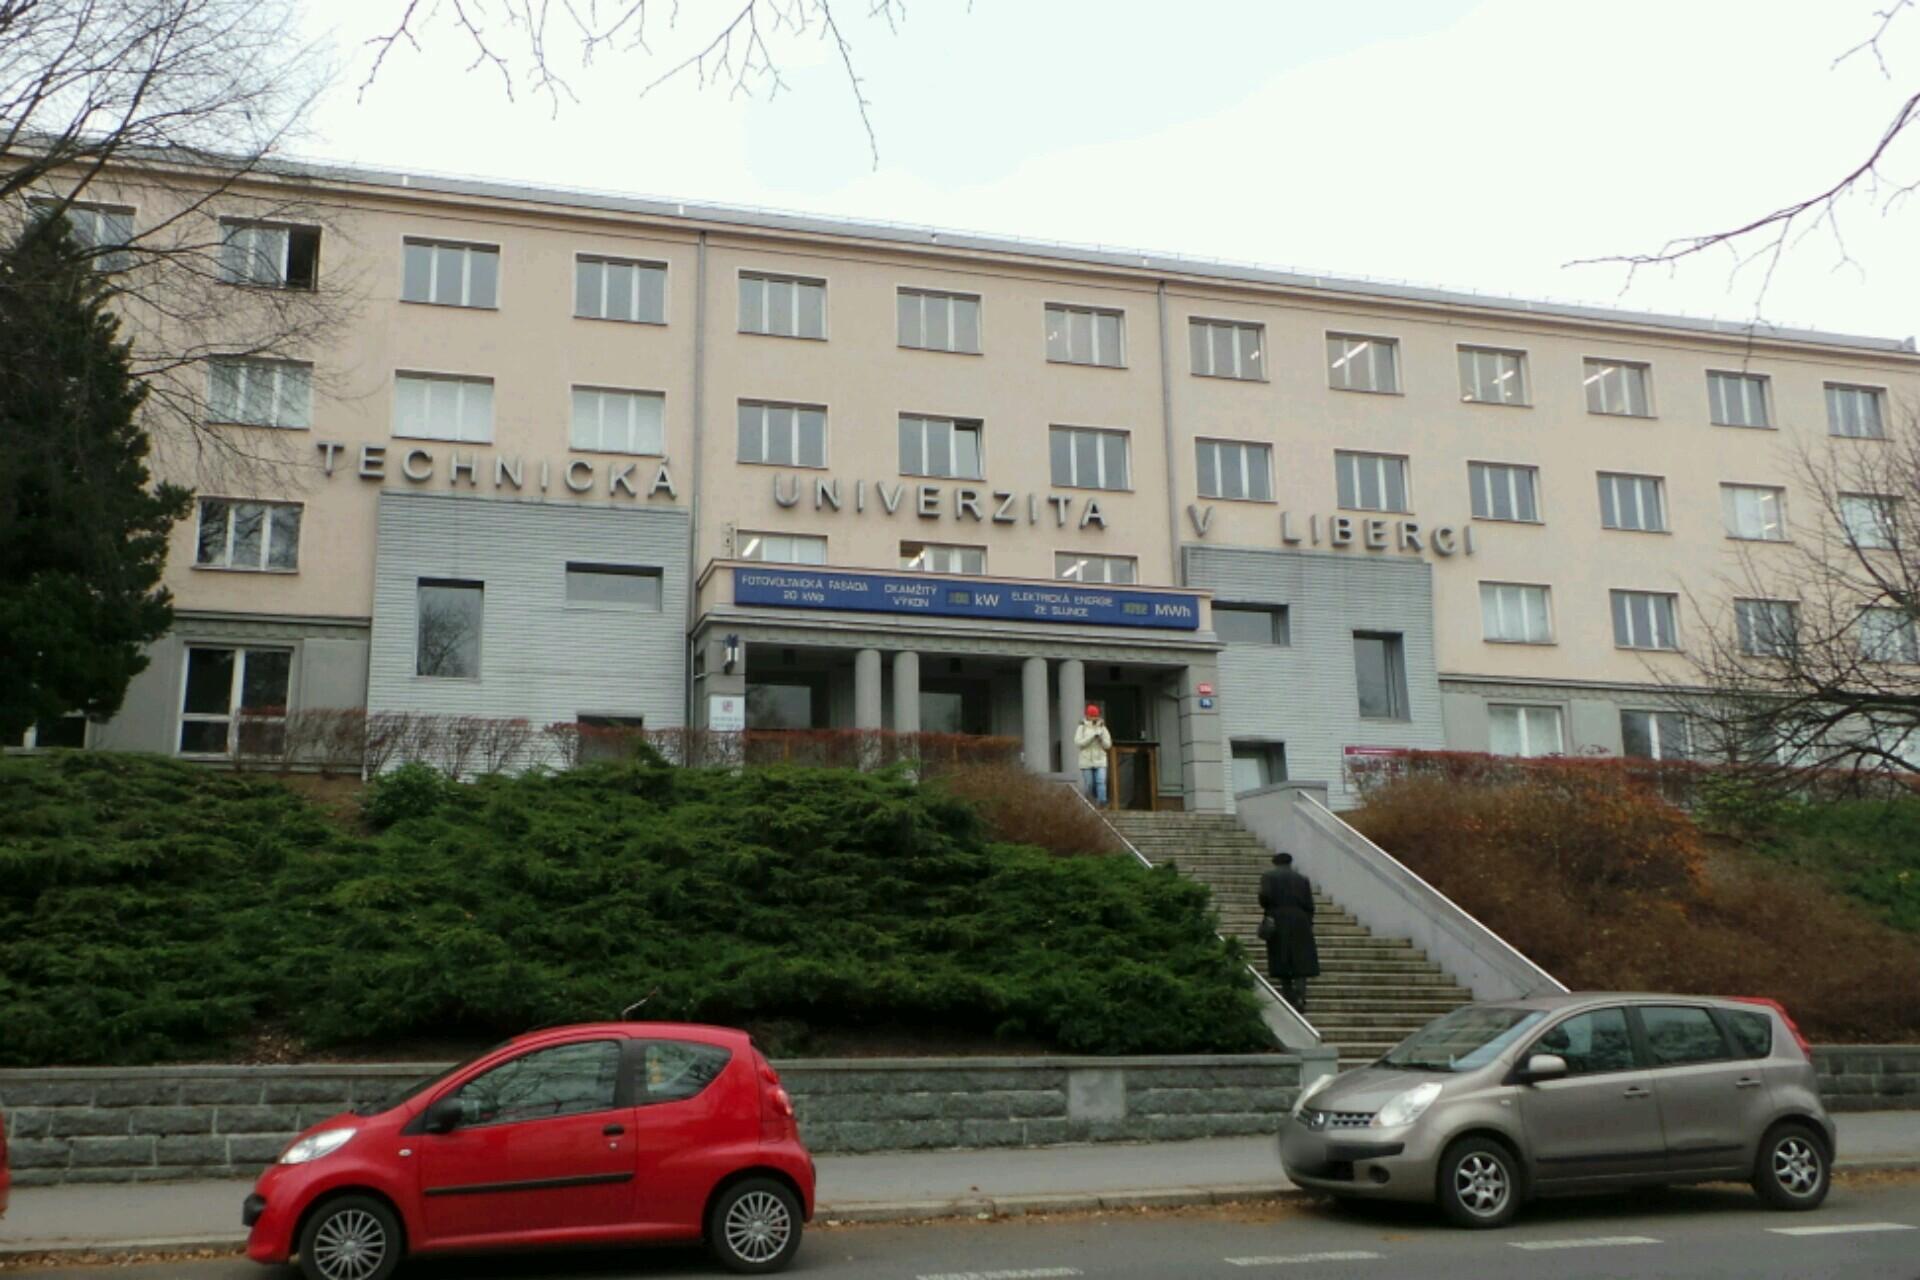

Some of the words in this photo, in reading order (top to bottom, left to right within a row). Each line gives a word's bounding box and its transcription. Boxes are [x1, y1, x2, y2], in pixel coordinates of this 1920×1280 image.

[317, 440, 677, 501] TECHNICKÁ
[773, 472, 1106, 530] UNIVERZITA
[1187, 503, 1216, 538] V
[1280, 510, 1475, 557] LIBERCI
[974, 593, 1000, 607] kW
[1154, 603, 1192, 617] MWh
